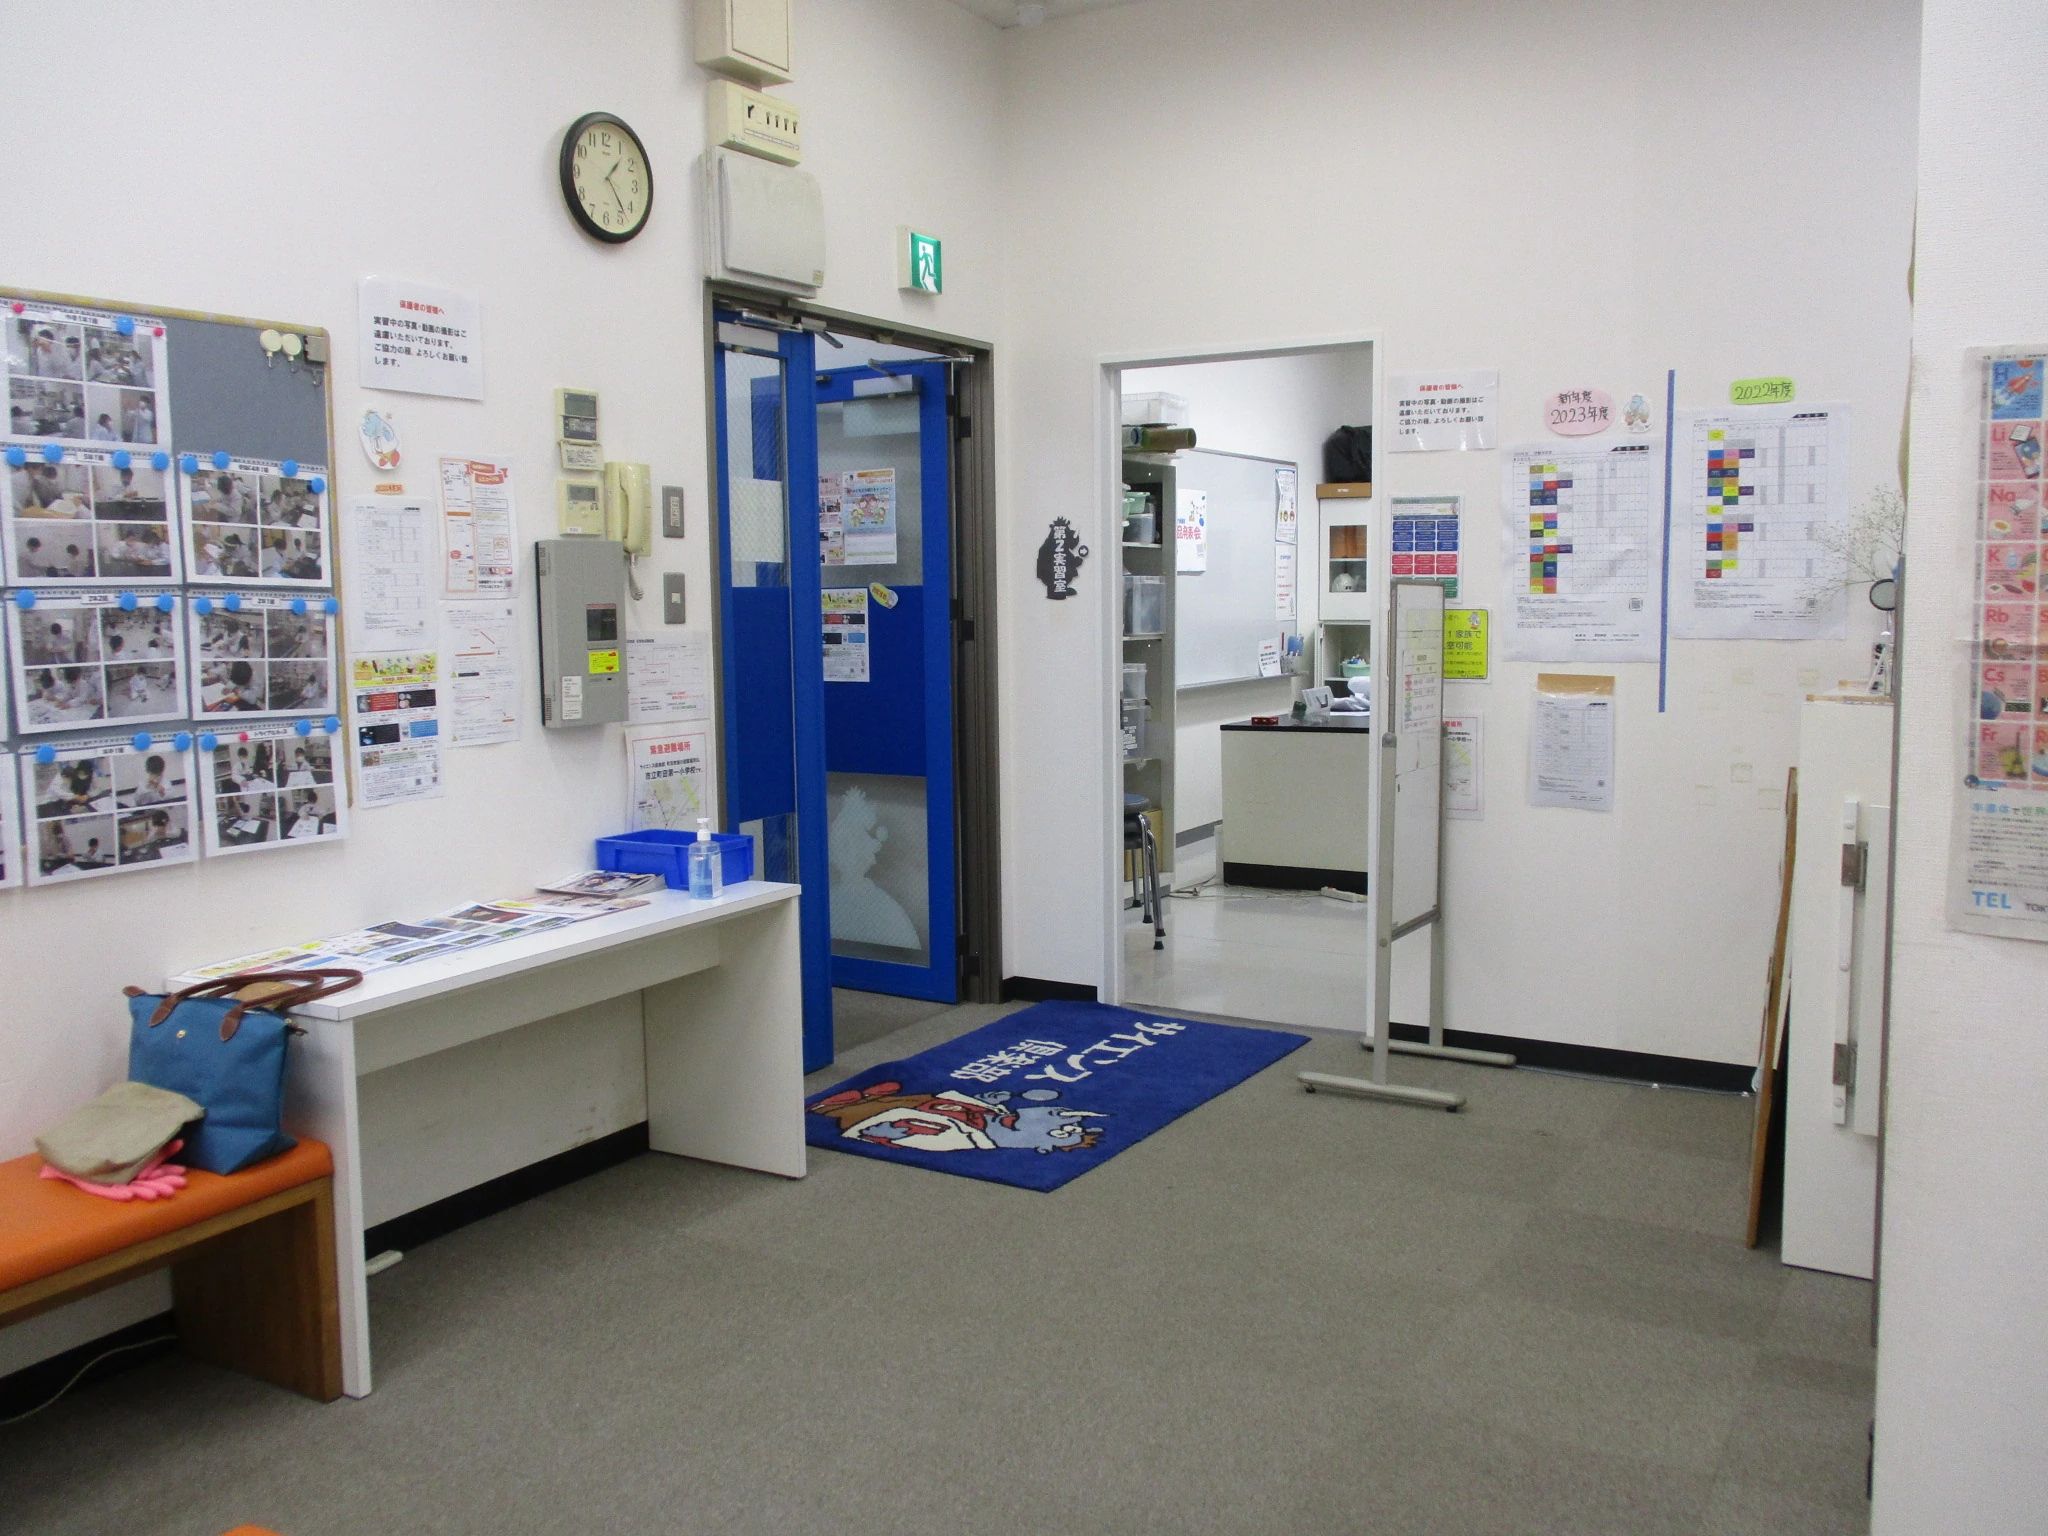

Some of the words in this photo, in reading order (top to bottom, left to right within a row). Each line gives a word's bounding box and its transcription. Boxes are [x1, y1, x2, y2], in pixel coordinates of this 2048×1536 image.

[588, 131, 596, 148] 11
[601, 131, 611, 147] 12
[577, 143, 588, 160] 10
[631, 180, 639, 194] 3
[374, 356, 401, 368] します。
[1558, 390, 1593, 404] 新年度
[1734, 382, 1792, 401] 2022年度
[1550, 405, 1610, 425] 2023年度
[1992, 427, 2006, 442] Li
[1990, 489, 2016, 502] Na
[1053, 525, 1067, 593] 第2実習室
[1988, 548, 2001, 562] K
[1986, 607, 2009, 623] Rb
[1983, 667, 2005, 682] Cs
[1981, 726, 1997, 741] Fr
[650, 742, 690, 754] 緊急避難場所
[1971, 890, 2012, 909] TEL
[1023, 1021, 1187, 1083] サイエンス
[950, 1038, 1068, 1083] 倶楽部
